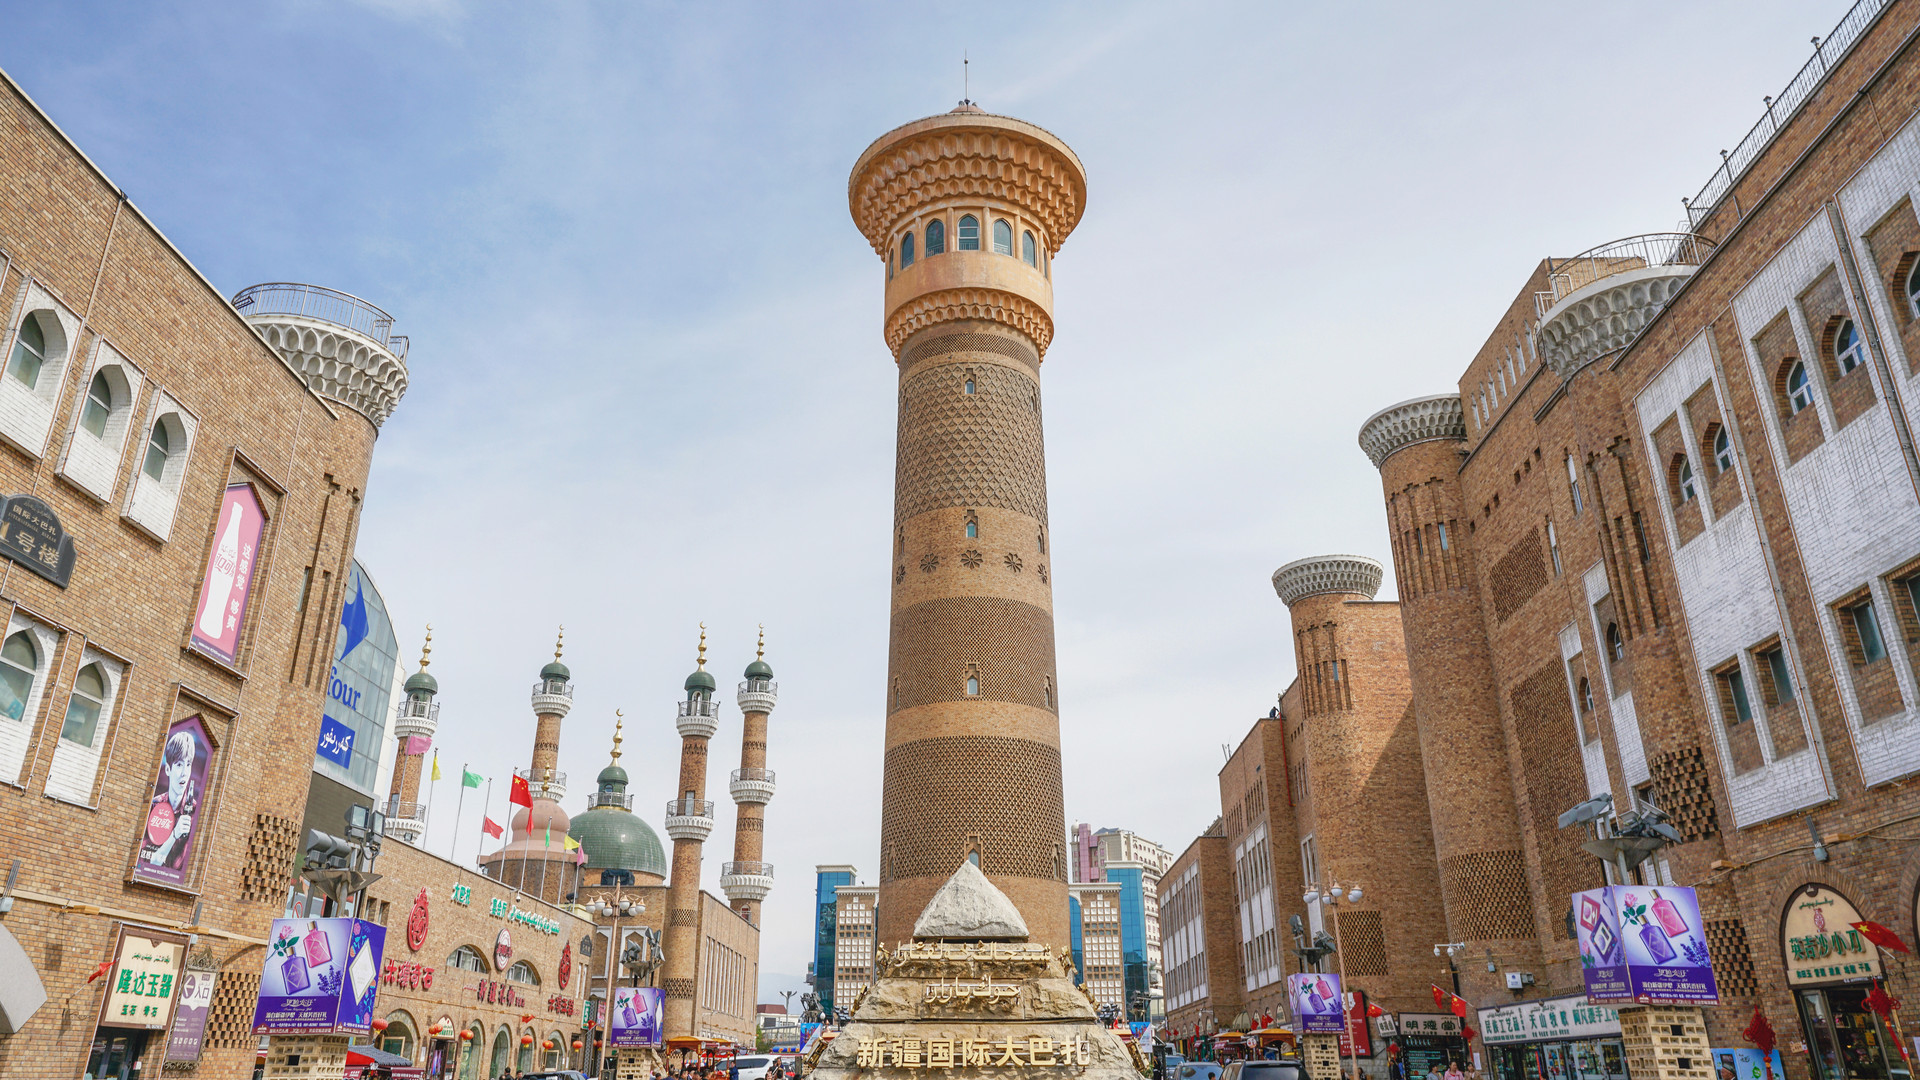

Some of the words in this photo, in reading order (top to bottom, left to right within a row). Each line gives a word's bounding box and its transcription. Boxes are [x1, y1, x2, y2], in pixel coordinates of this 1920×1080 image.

[12, 504, 56, 536] 国际大巴扎
[451, 882, 471, 906] 大巴扎
[1789, 929, 1863, 961] 英吉沙小刀
[116, 969, 174, 998] 隆达玉器
[195, 986, 210, 999] 入口
[121, 1004, 137, 1016] 玉石
[1529, 1011, 1569, 1029] 天山牧歌
[1485, 1014, 1521, 1034] 民族工艺品
[856, 1035, 1090, 1068] 新疆国际大巴扎
